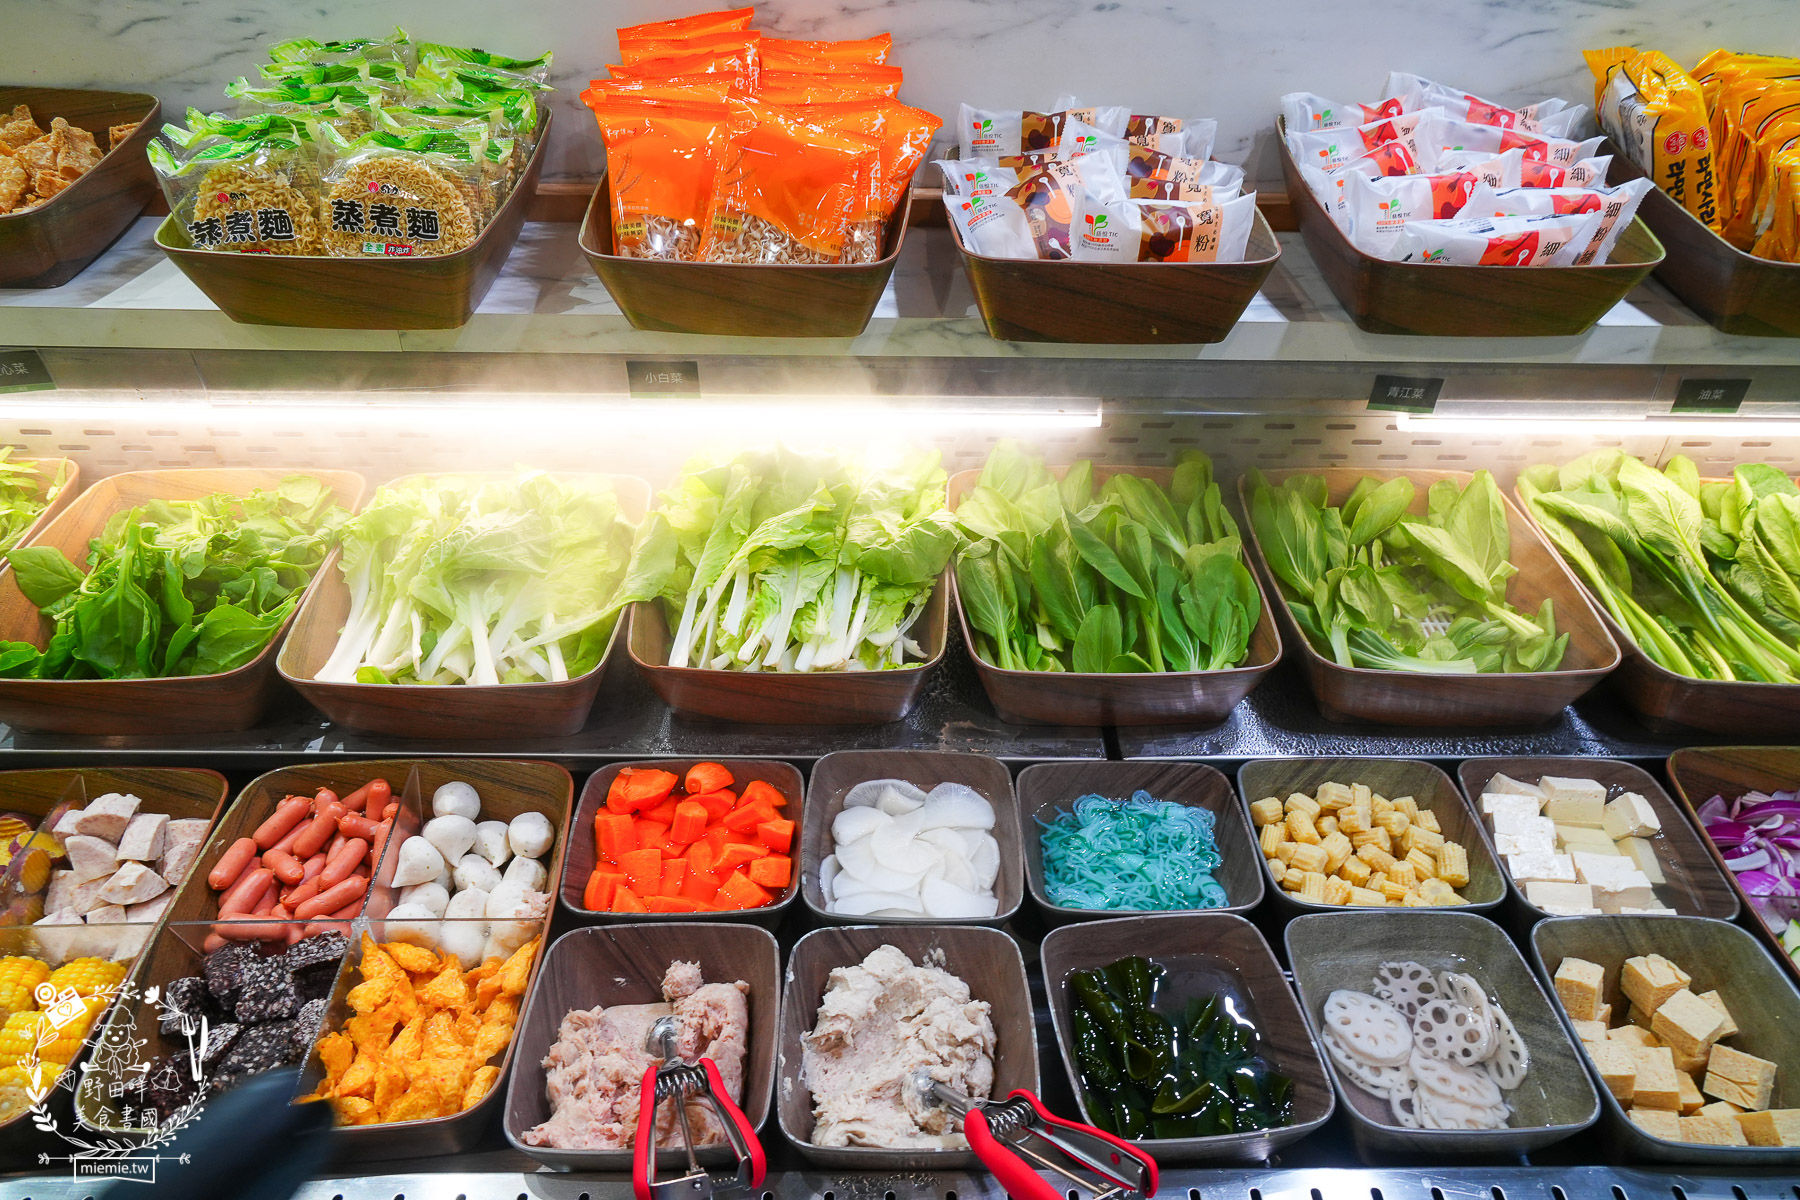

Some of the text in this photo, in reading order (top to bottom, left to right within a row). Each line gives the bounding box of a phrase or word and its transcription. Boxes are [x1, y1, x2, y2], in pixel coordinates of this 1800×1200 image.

[331, 198, 440, 240] 蒸煮麵
[187, 208, 295, 246] 蒸煮麵
[0, 362, 30, 376] 心菜
[645, 372, 683, 384] 小白菜
[1387, 386, 1426, 399] 青江菜
[1698, 389, 1725, 401] 油菜
